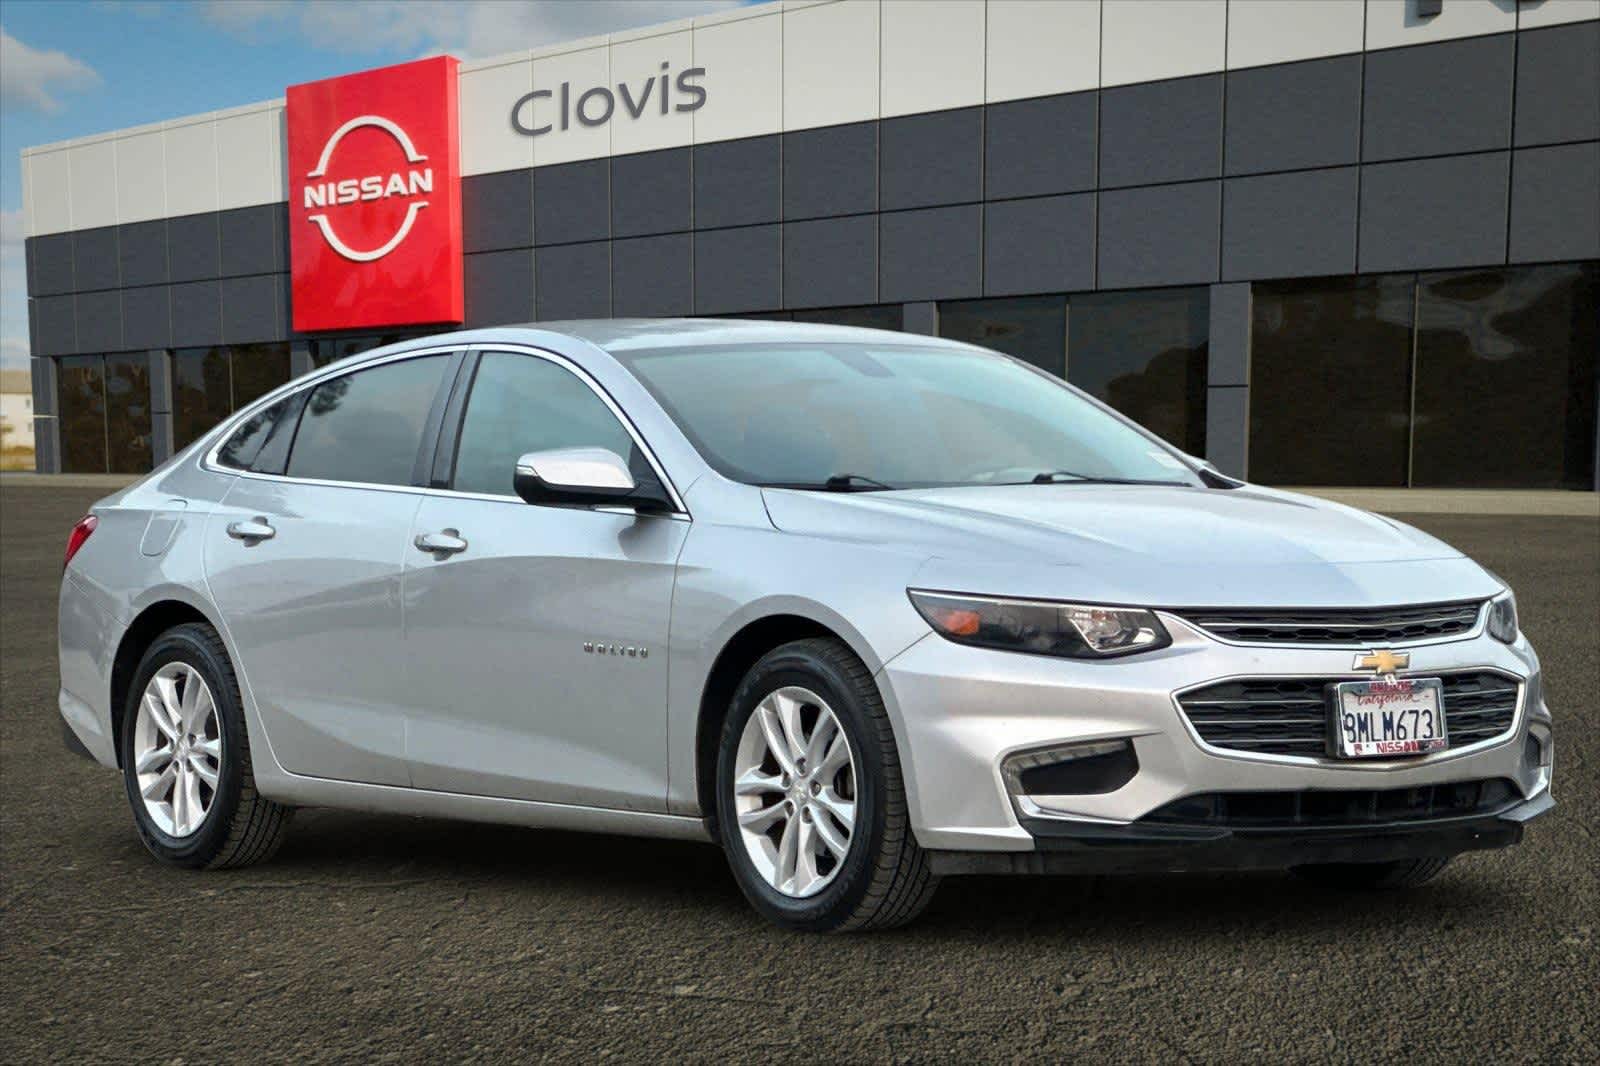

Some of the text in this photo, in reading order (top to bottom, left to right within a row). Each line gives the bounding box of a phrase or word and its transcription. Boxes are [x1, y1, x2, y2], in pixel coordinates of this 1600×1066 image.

[511, 61, 707, 136] Clovis
[303, 168, 433, 209] NISSAN
[1343, 709, 1434, 743] 8MLM673
